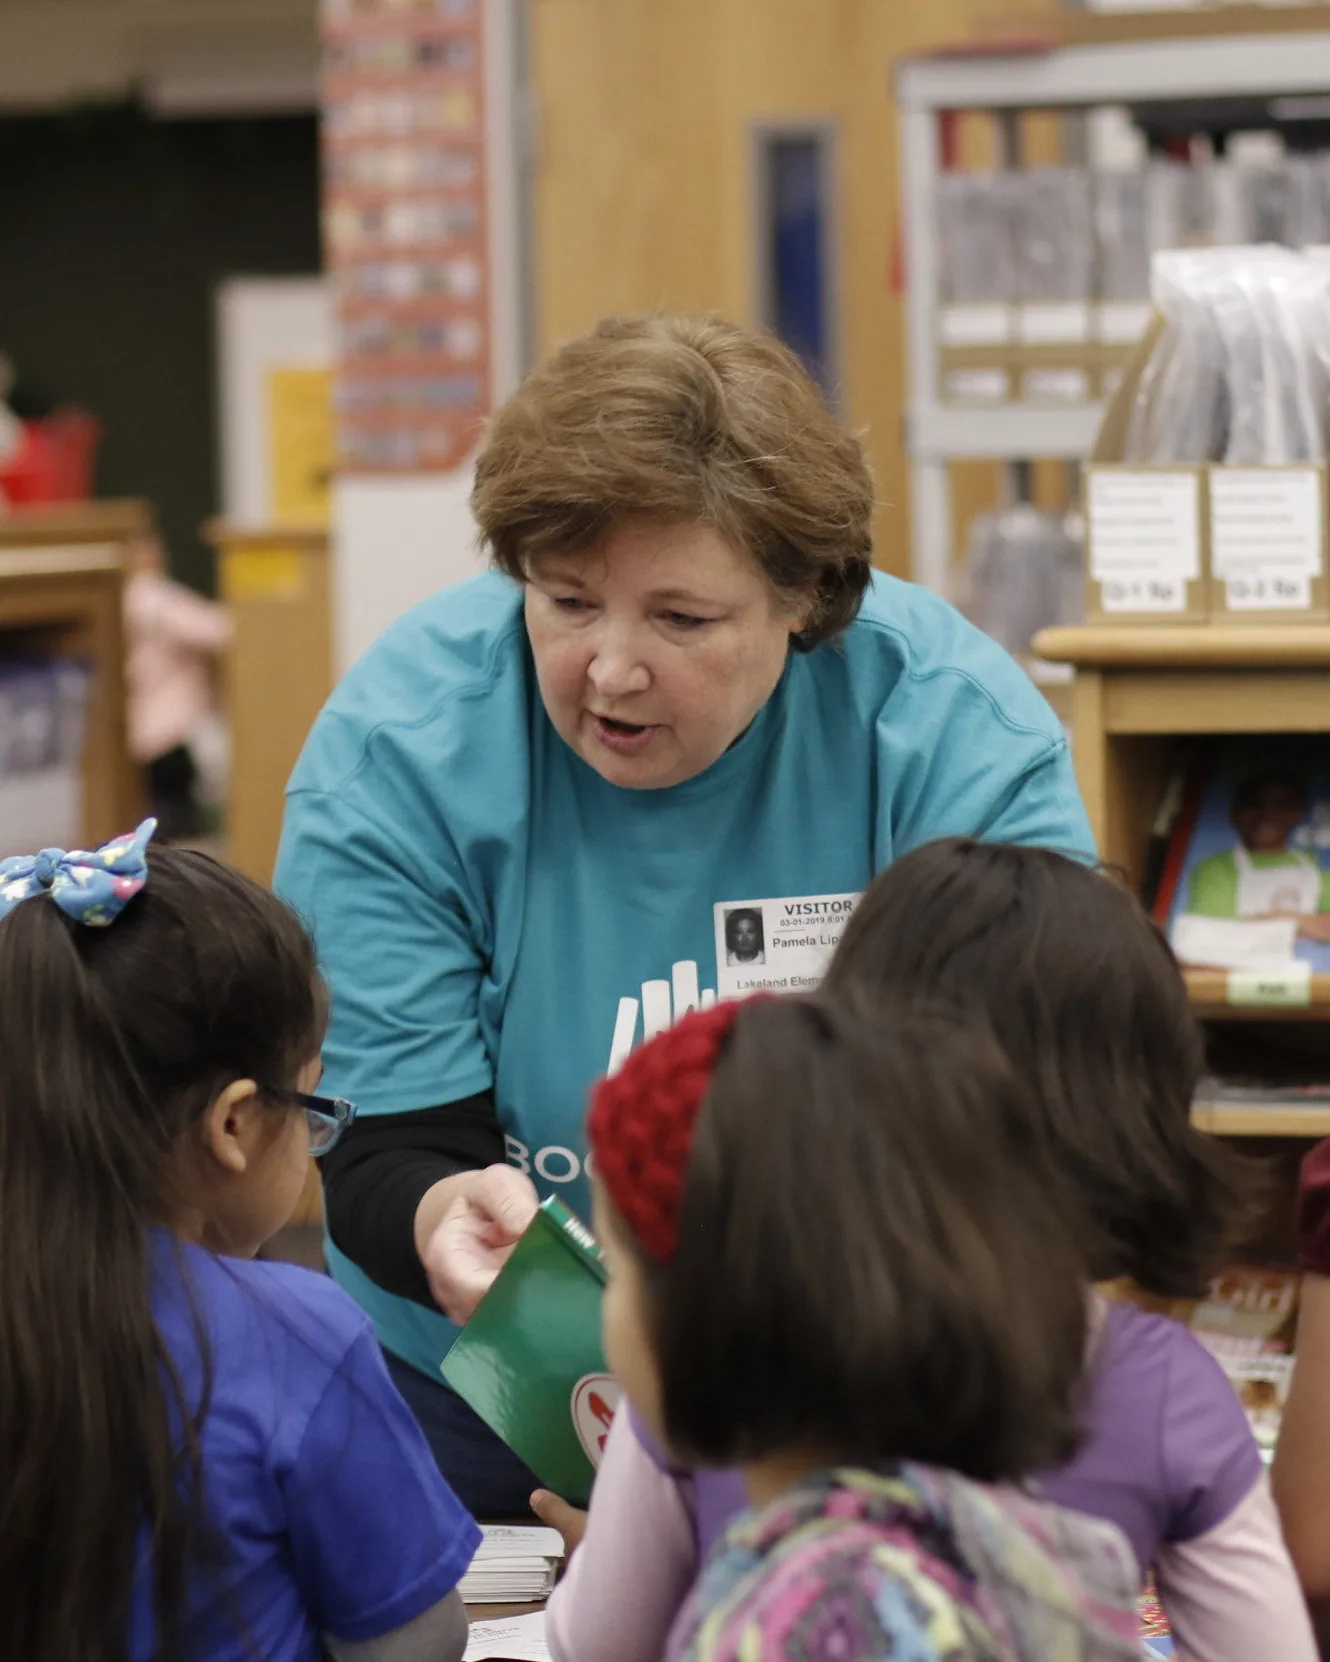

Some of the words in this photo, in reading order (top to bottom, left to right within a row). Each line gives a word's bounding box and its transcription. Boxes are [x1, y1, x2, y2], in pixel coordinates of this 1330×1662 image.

[784, 900, 853, 916] VISITOR
[780, 916, 825, 927] 03-01-2019
[772, 936, 817, 948] Pamela
[820, 934, 842, 946] Lip
[737, 977, 787, 990] Lakeland
